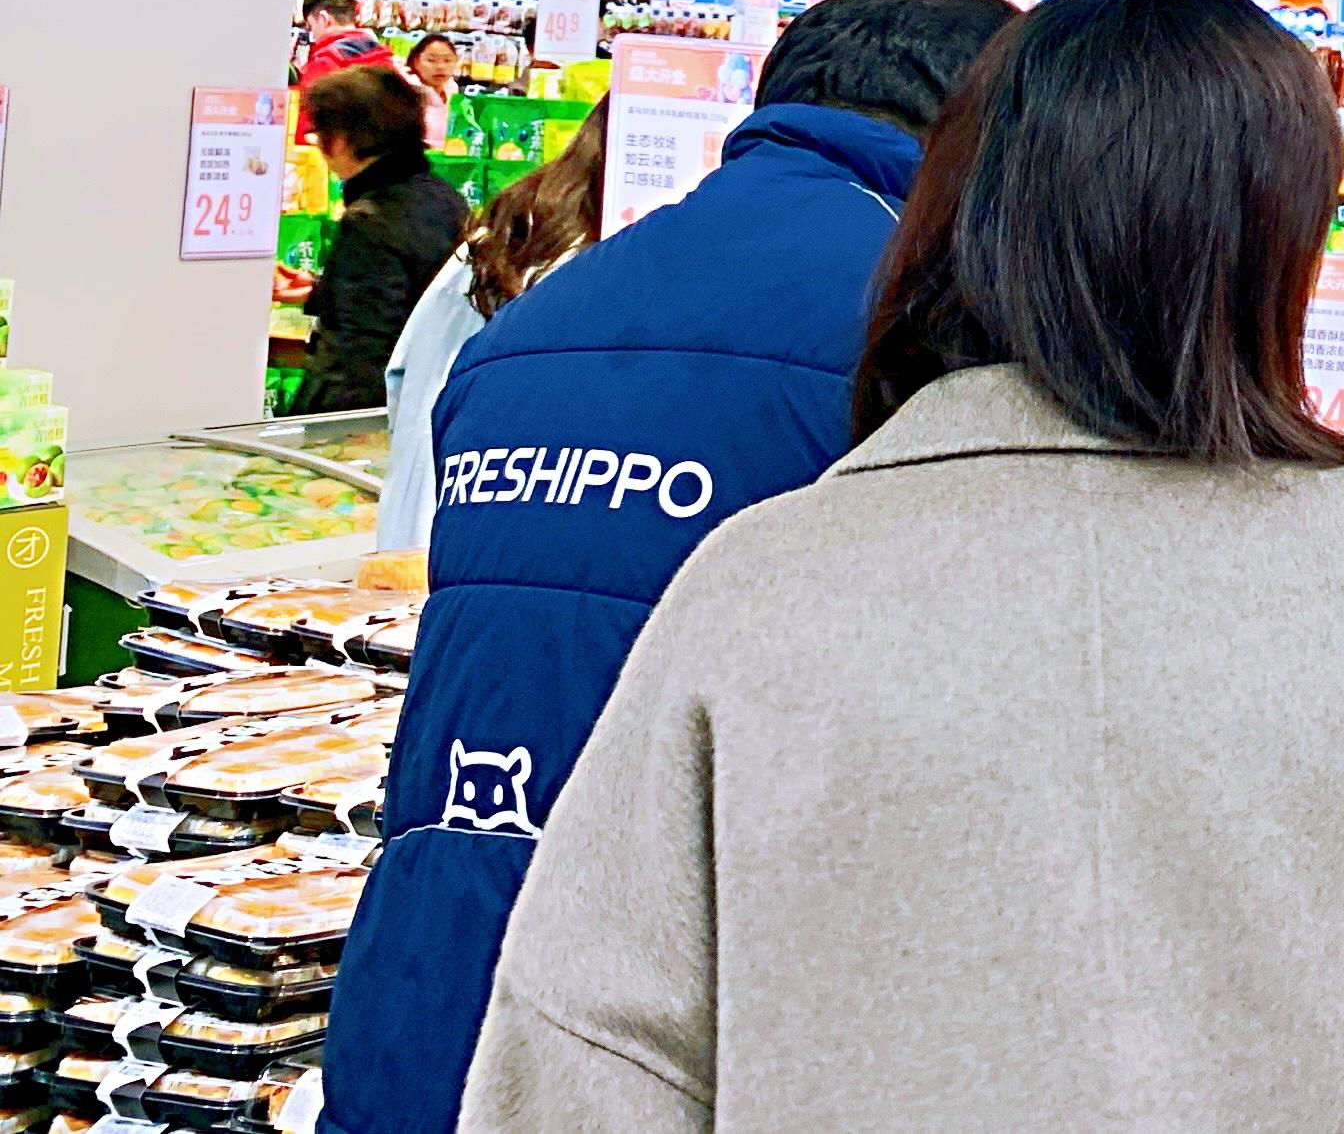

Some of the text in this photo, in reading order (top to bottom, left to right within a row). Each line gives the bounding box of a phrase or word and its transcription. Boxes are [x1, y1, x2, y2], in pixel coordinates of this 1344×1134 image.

[626, 133, 677, 150] 生态牧场
[624, 171, 675, 189] 口感轻盈
[437, 447, 714, 518] FRESHIPPO
[20, 586, 47, 686] FRESH
